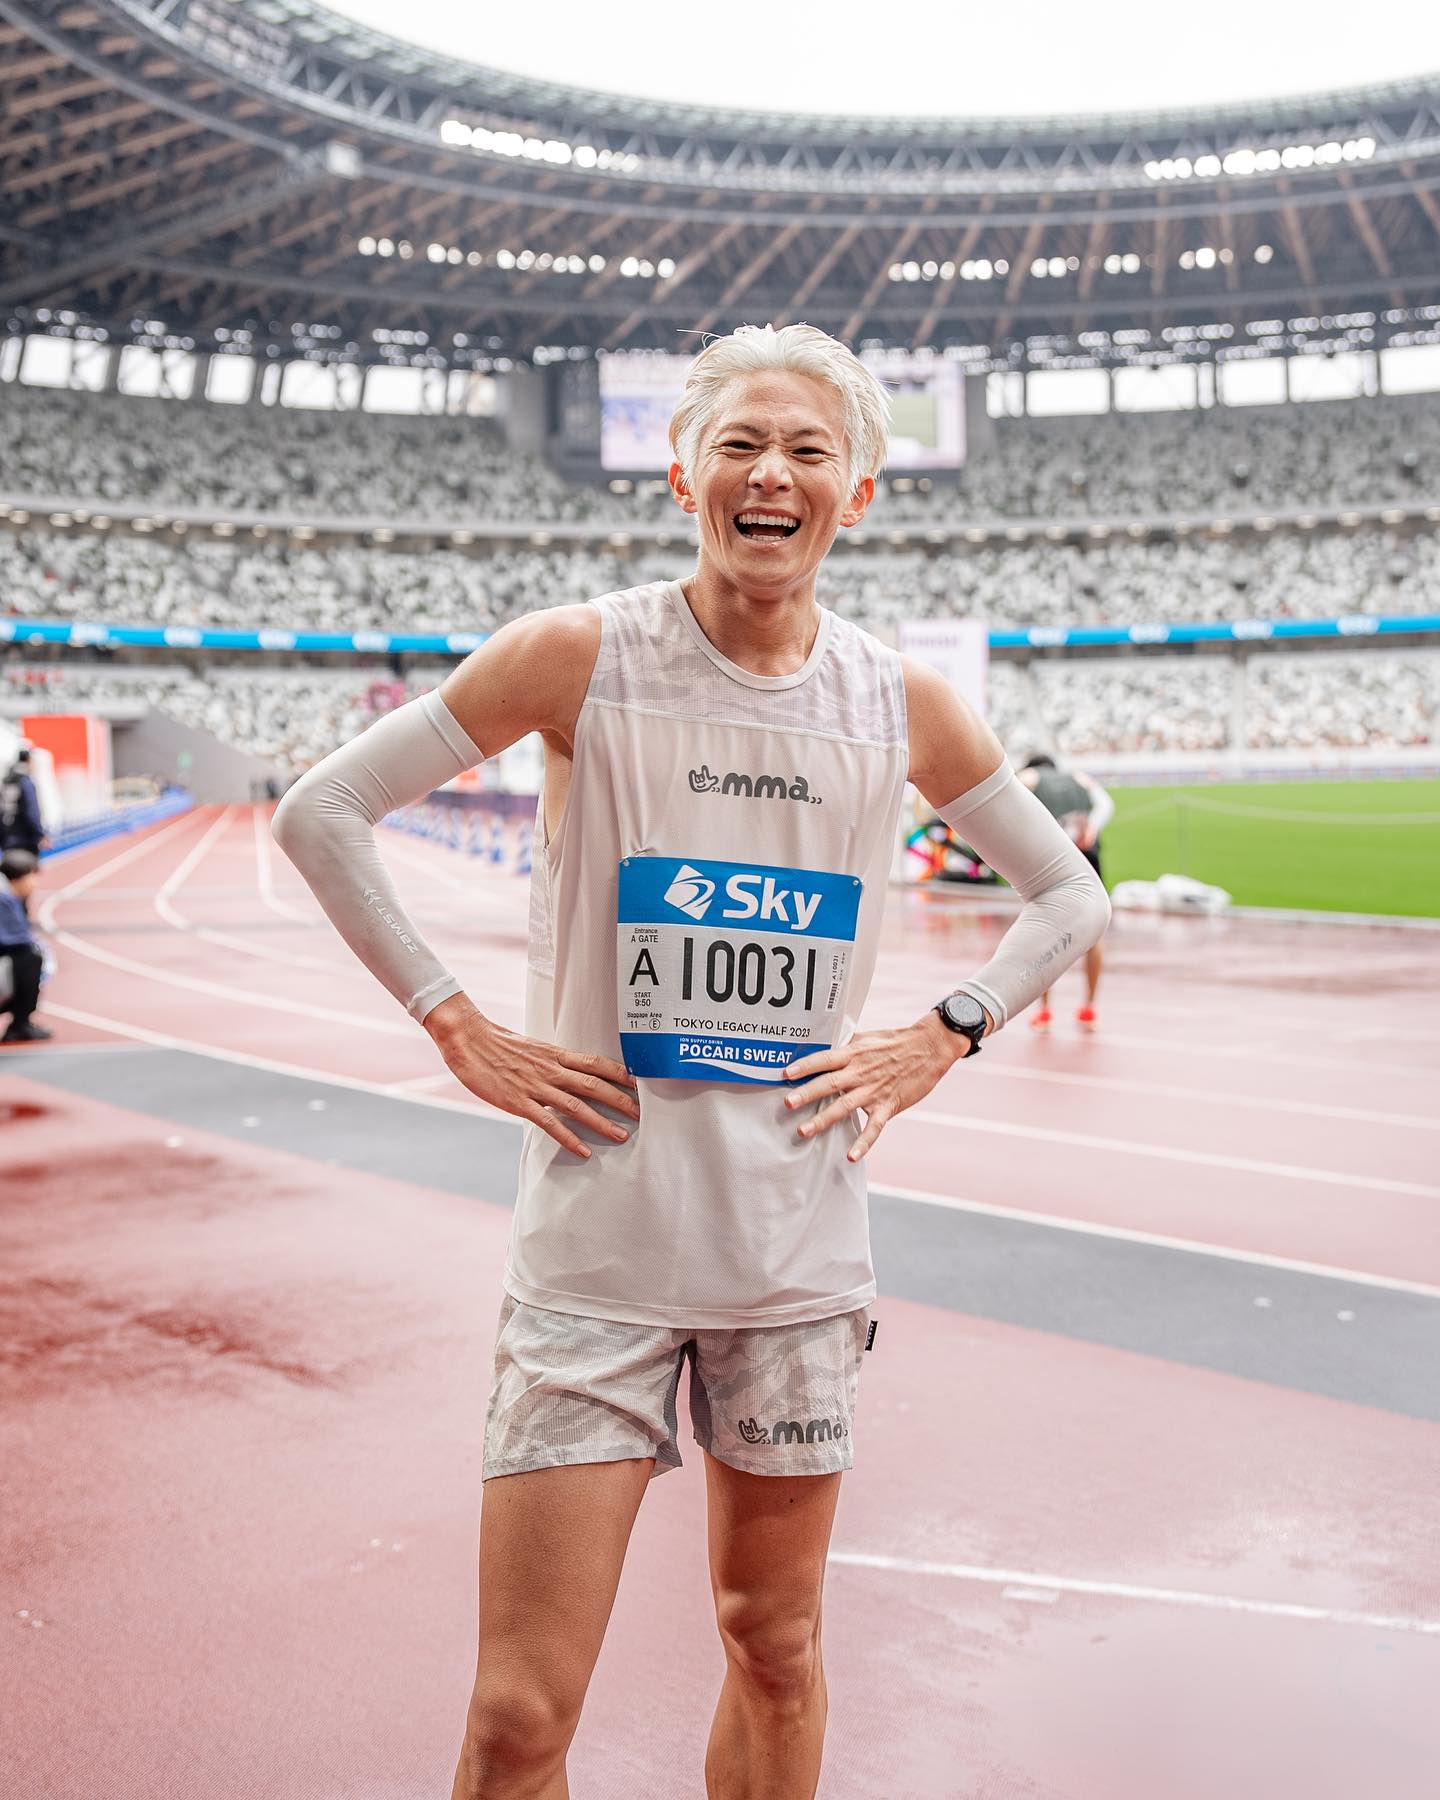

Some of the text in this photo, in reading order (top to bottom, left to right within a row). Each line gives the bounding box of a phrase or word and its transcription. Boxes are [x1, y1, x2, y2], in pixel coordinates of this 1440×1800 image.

[722, 873, 823, 930] Sky
[630, 934, 659, 943] A GATE
[628, 948, 660, 986] A
[682, 937, 816, 1011] 10031
[634, 998, 651, 1007] 9:50
[626, 1011, 649, 1019] Baggage
[630, 1020, 638, 1029] 11
[673, 1017, 811, 1038] TOKYO LEGACY HALF 2023
[679, 1043, 793, 1064] POCARI SWEAT
